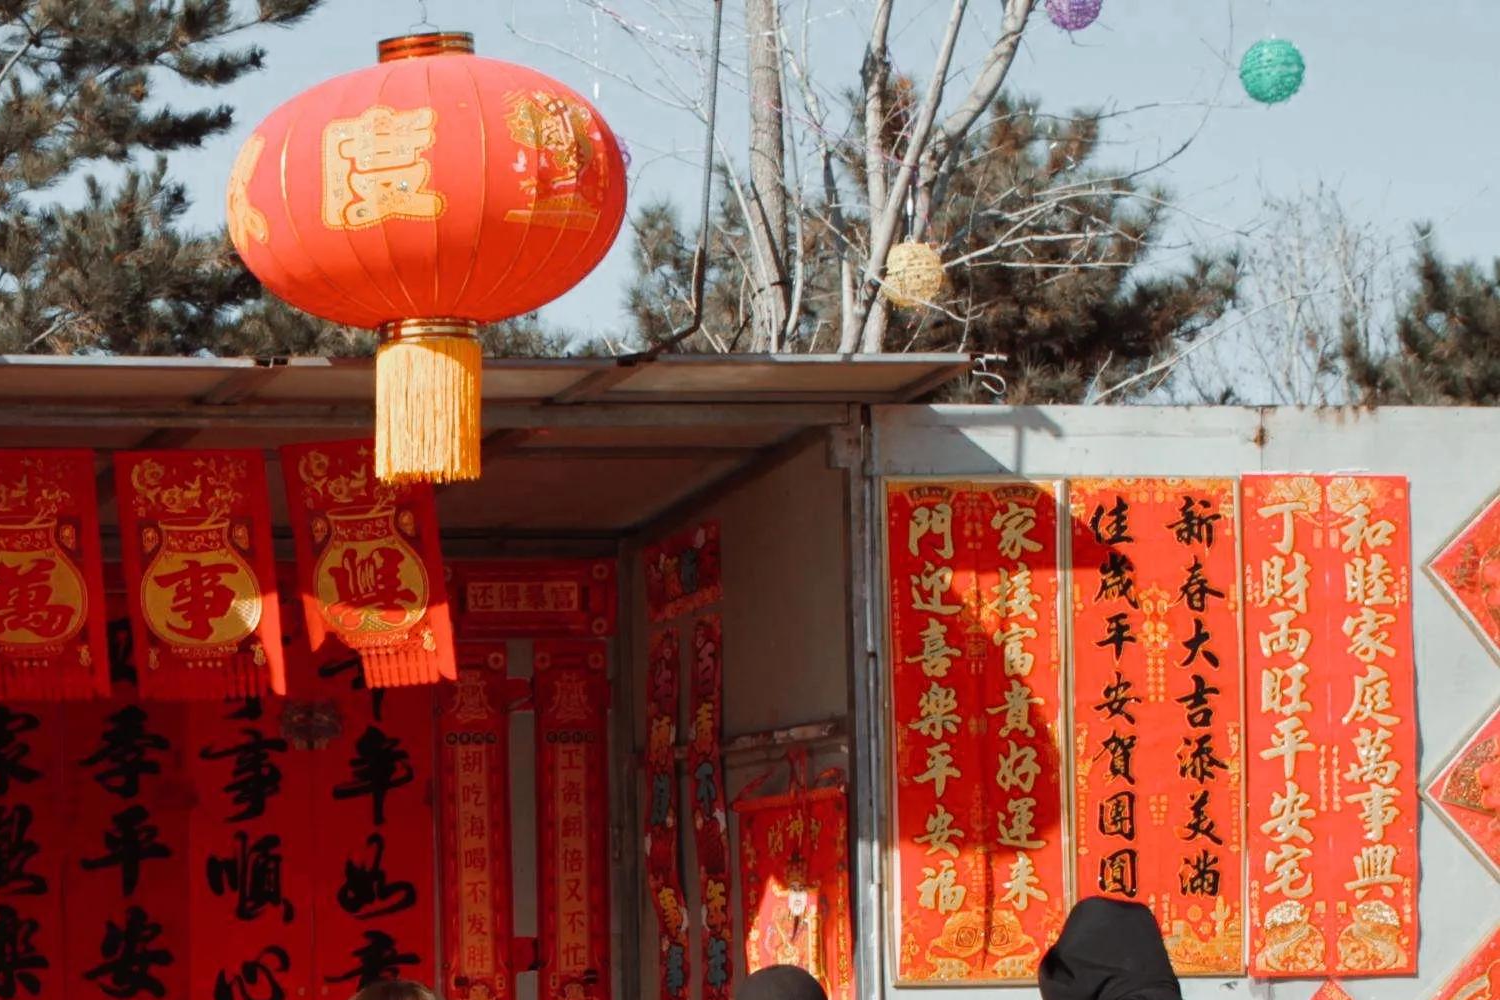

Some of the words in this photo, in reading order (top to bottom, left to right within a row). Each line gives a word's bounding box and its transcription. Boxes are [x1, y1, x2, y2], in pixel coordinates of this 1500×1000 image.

[153, 559, 239, 641] 事
[329, 546, 417, 630] 興
[906, 502, 967, 916] 門迎喜樂平安福
[1168, 496, 1230, 897] 新春大吉添美滿
[1340, 502, 1402, 900] 和睦家庭萬事興
[459, 748, 488, 970] 胡吃海喝不发胖
[561, 748, 587, 968] 工资翻倍又不忙
